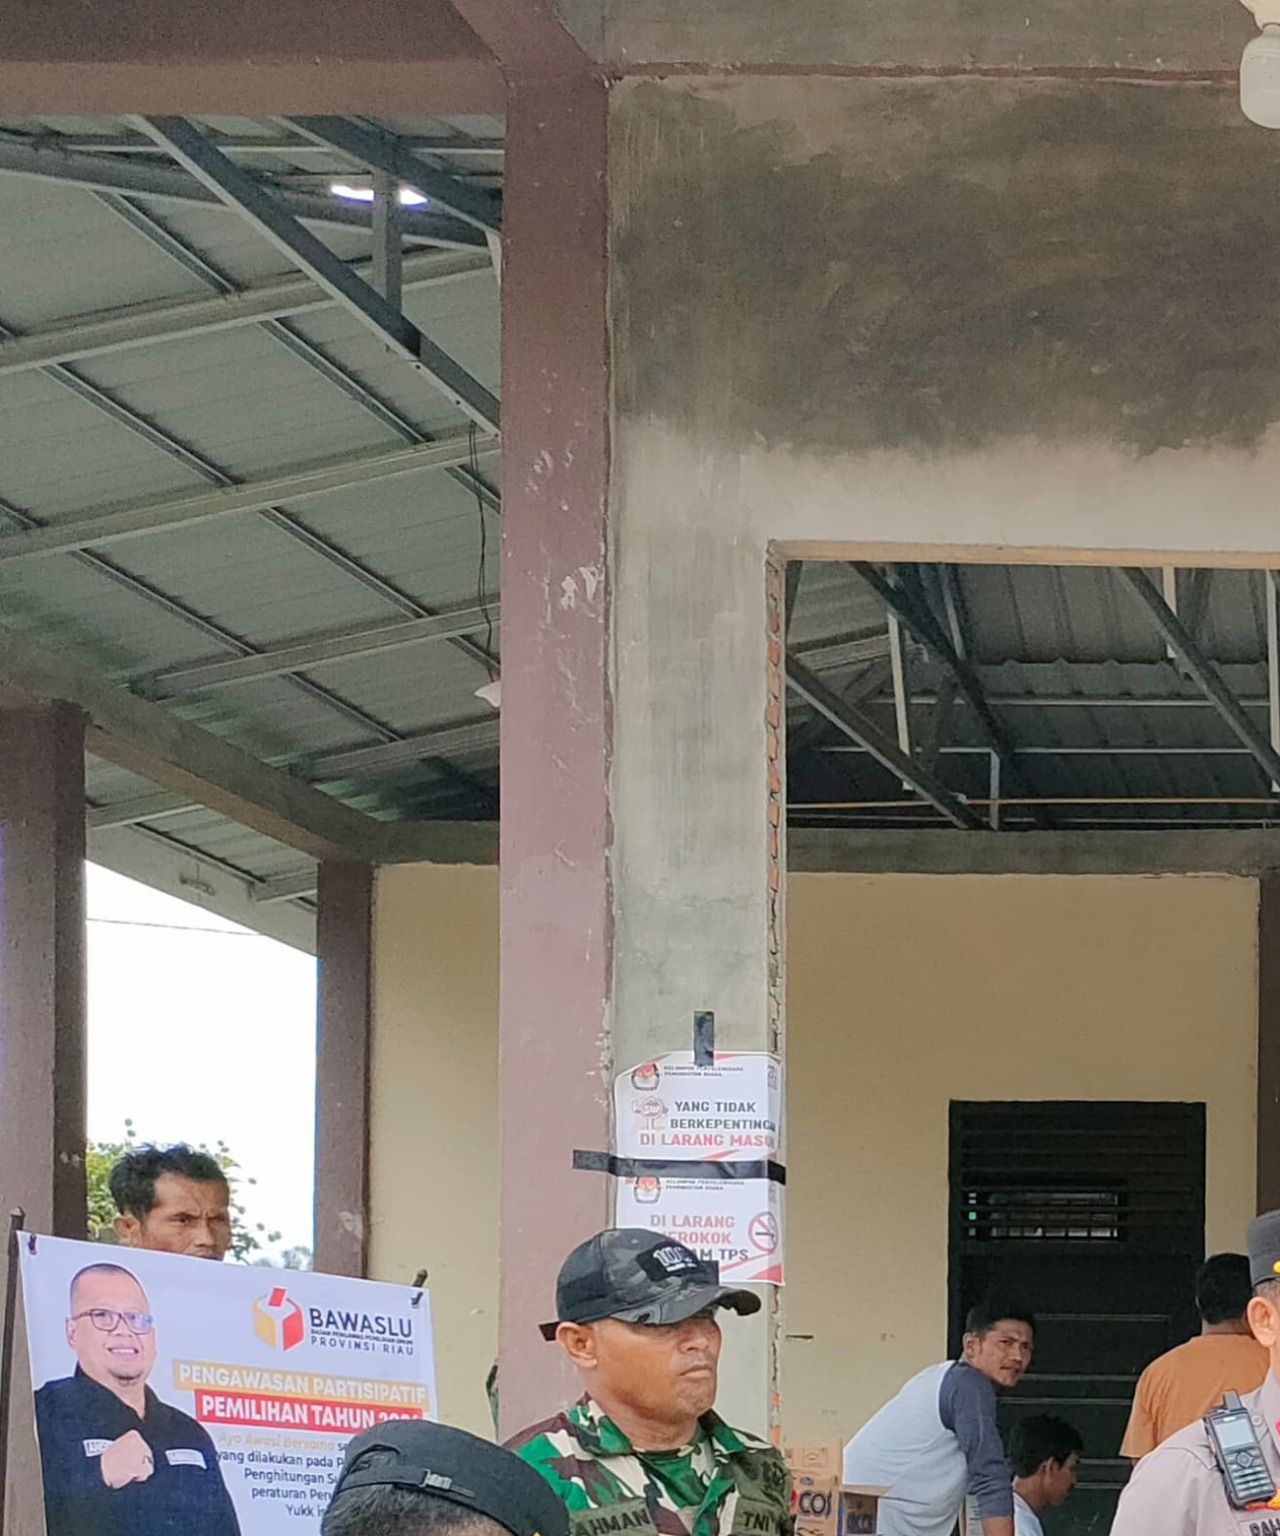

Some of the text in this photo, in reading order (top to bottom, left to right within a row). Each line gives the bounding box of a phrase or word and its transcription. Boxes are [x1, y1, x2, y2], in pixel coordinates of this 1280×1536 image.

[674, 1101, 756, 1112] YANG TIDAK
[640, 1134, 656, 1146] DI
[661, 1134, 724, 1146] LARANG
[650, 1214, 735, 1228] DI LARANG
[718, 1248, 750, 1262] TPS
[309, 1307, 412, 1338] BAWASLU
[311, 1336, 414, 1356] PROVINSI RIAU
[179, 1363, 426, 1405] PENGAWASAN PARTISIPATIF
[202, 1394, 308, 1424] PEMILIHAN
[311, 1405, 375, 1428] TAHUN
[247, 1450, 303, 1466] dilakukan
[306, 1454, 334, 1469] pada
[244, 1468, 324, 1485] Penghitungan
[252, 1487, 307, 1502] peraturan
[286, 1505, 314, 1516] Yukk
[744, 1511, 770, 1532] TNI
